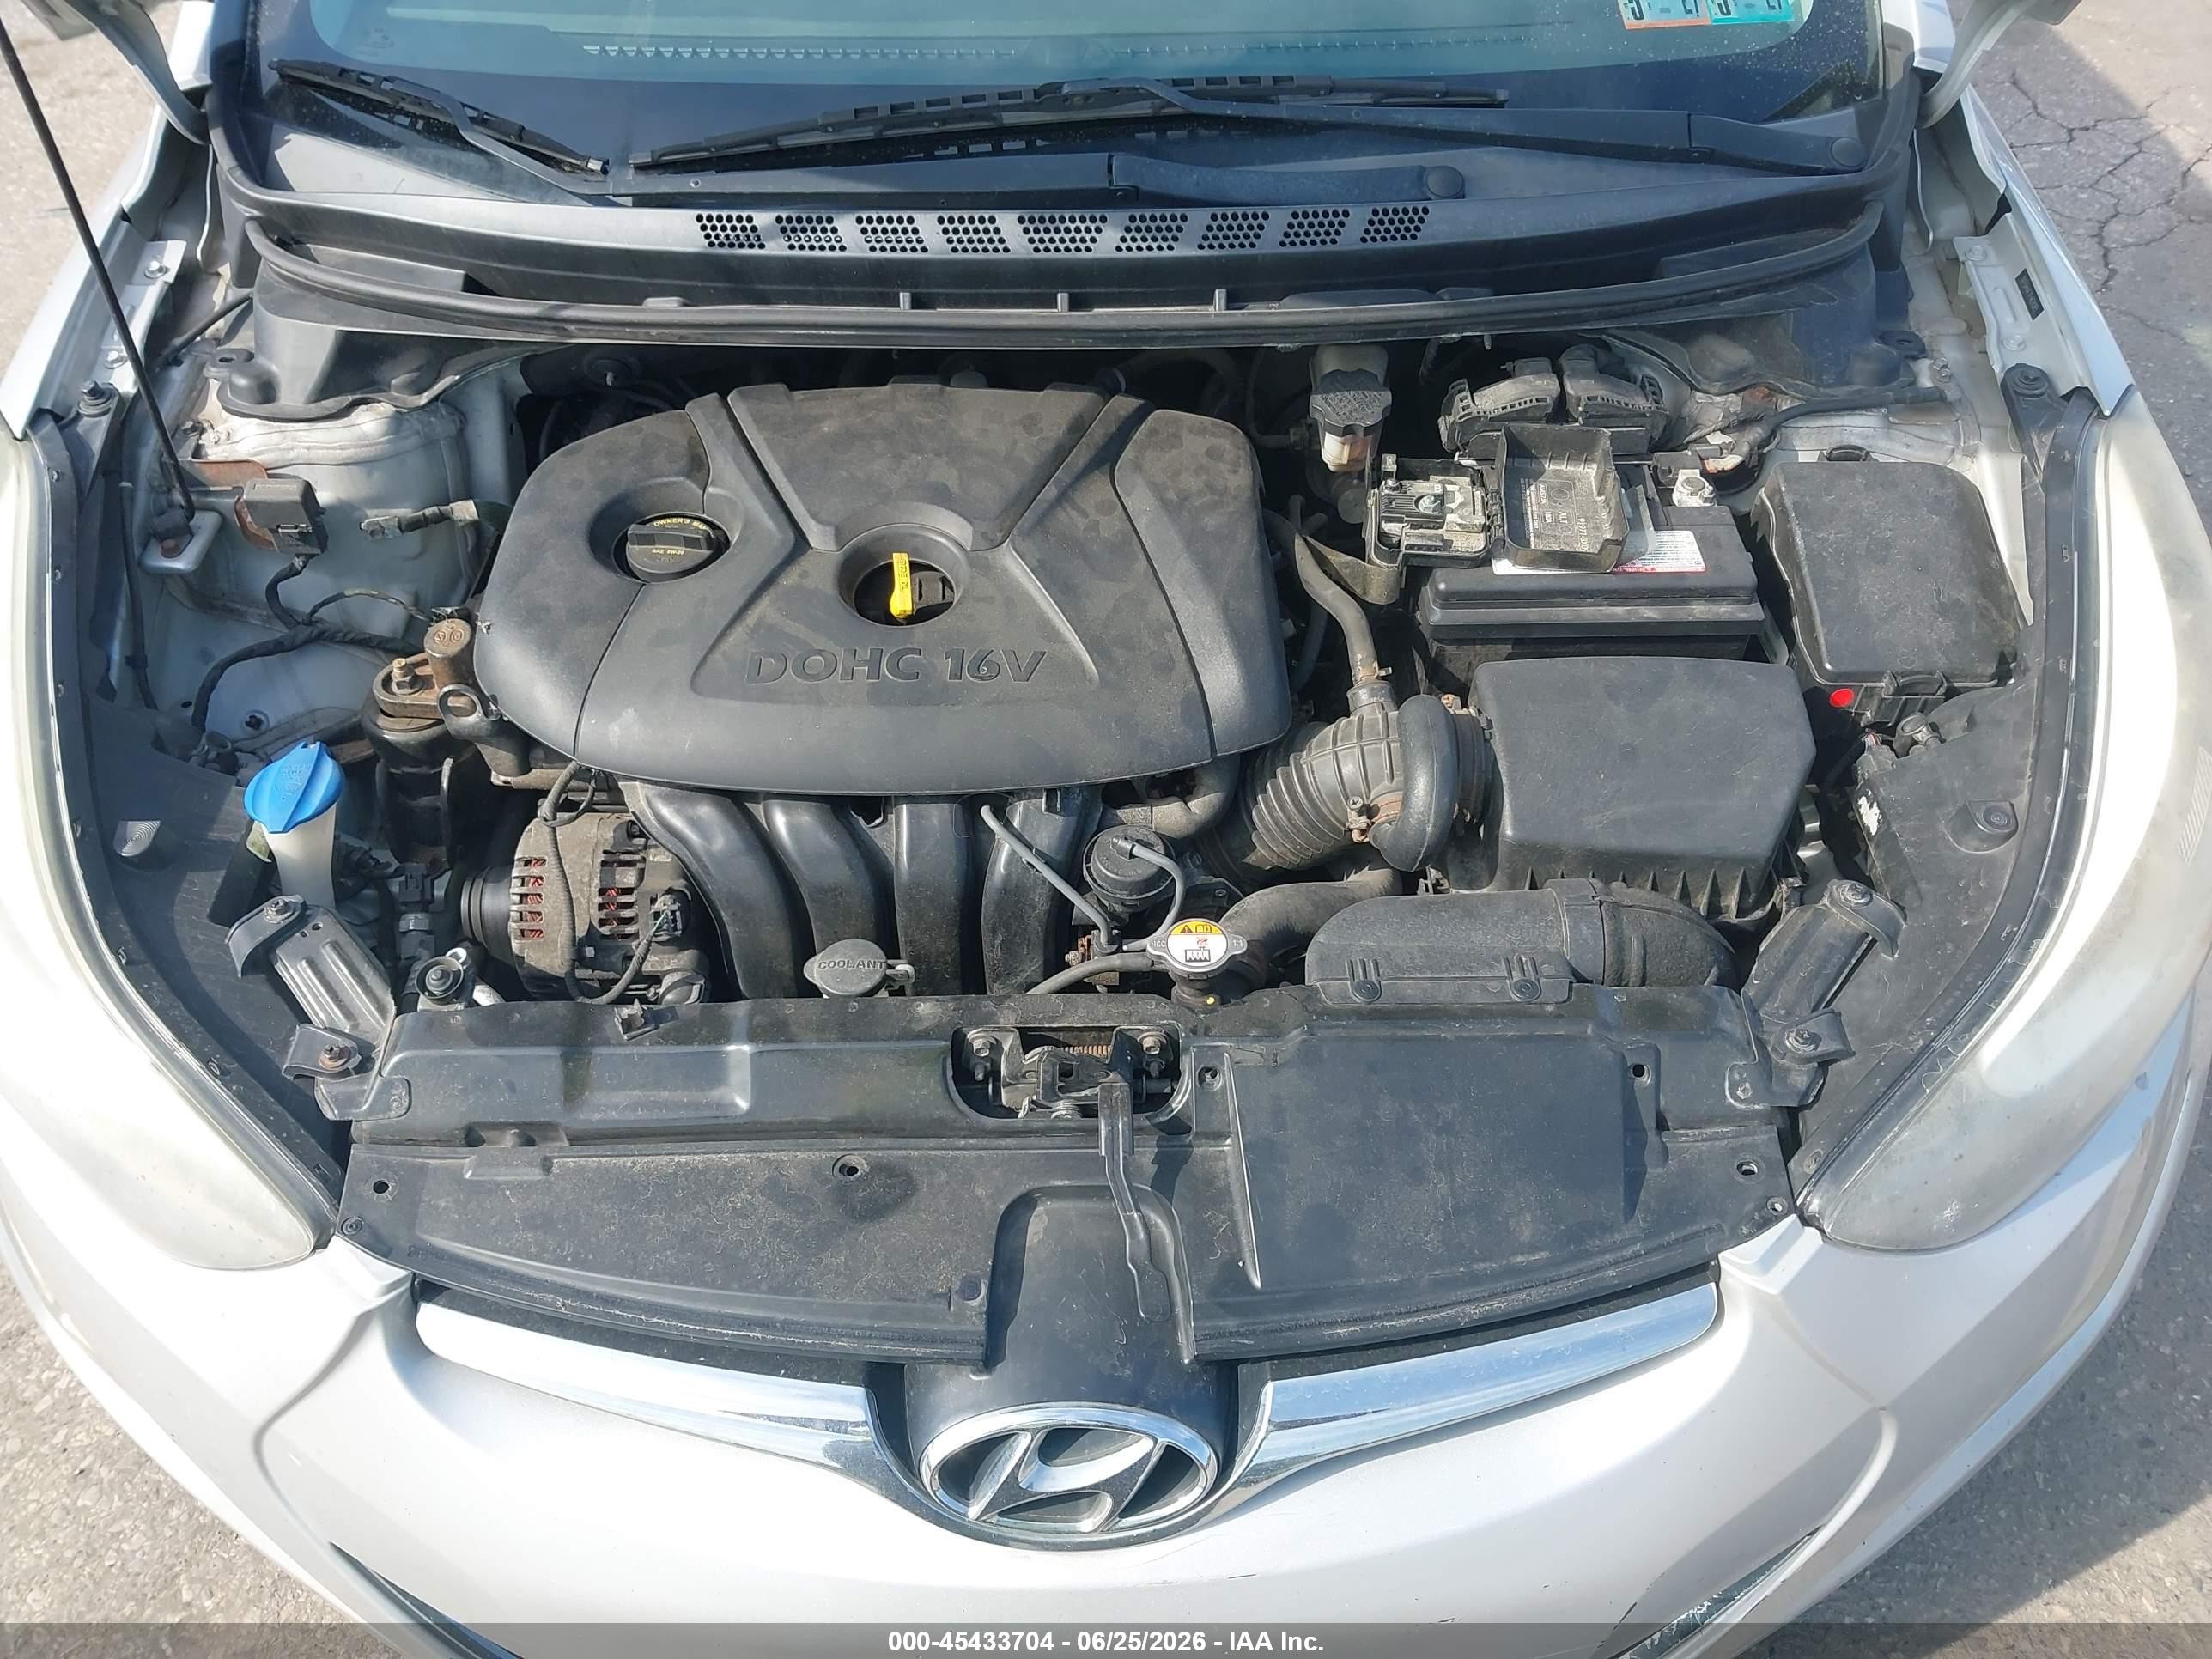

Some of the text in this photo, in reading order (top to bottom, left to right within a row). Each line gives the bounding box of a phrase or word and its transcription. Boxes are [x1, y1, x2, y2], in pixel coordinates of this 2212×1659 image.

[746, 647, 1048, 684] DOHC 16V
[818, 959, 886, 969] COOLANT
